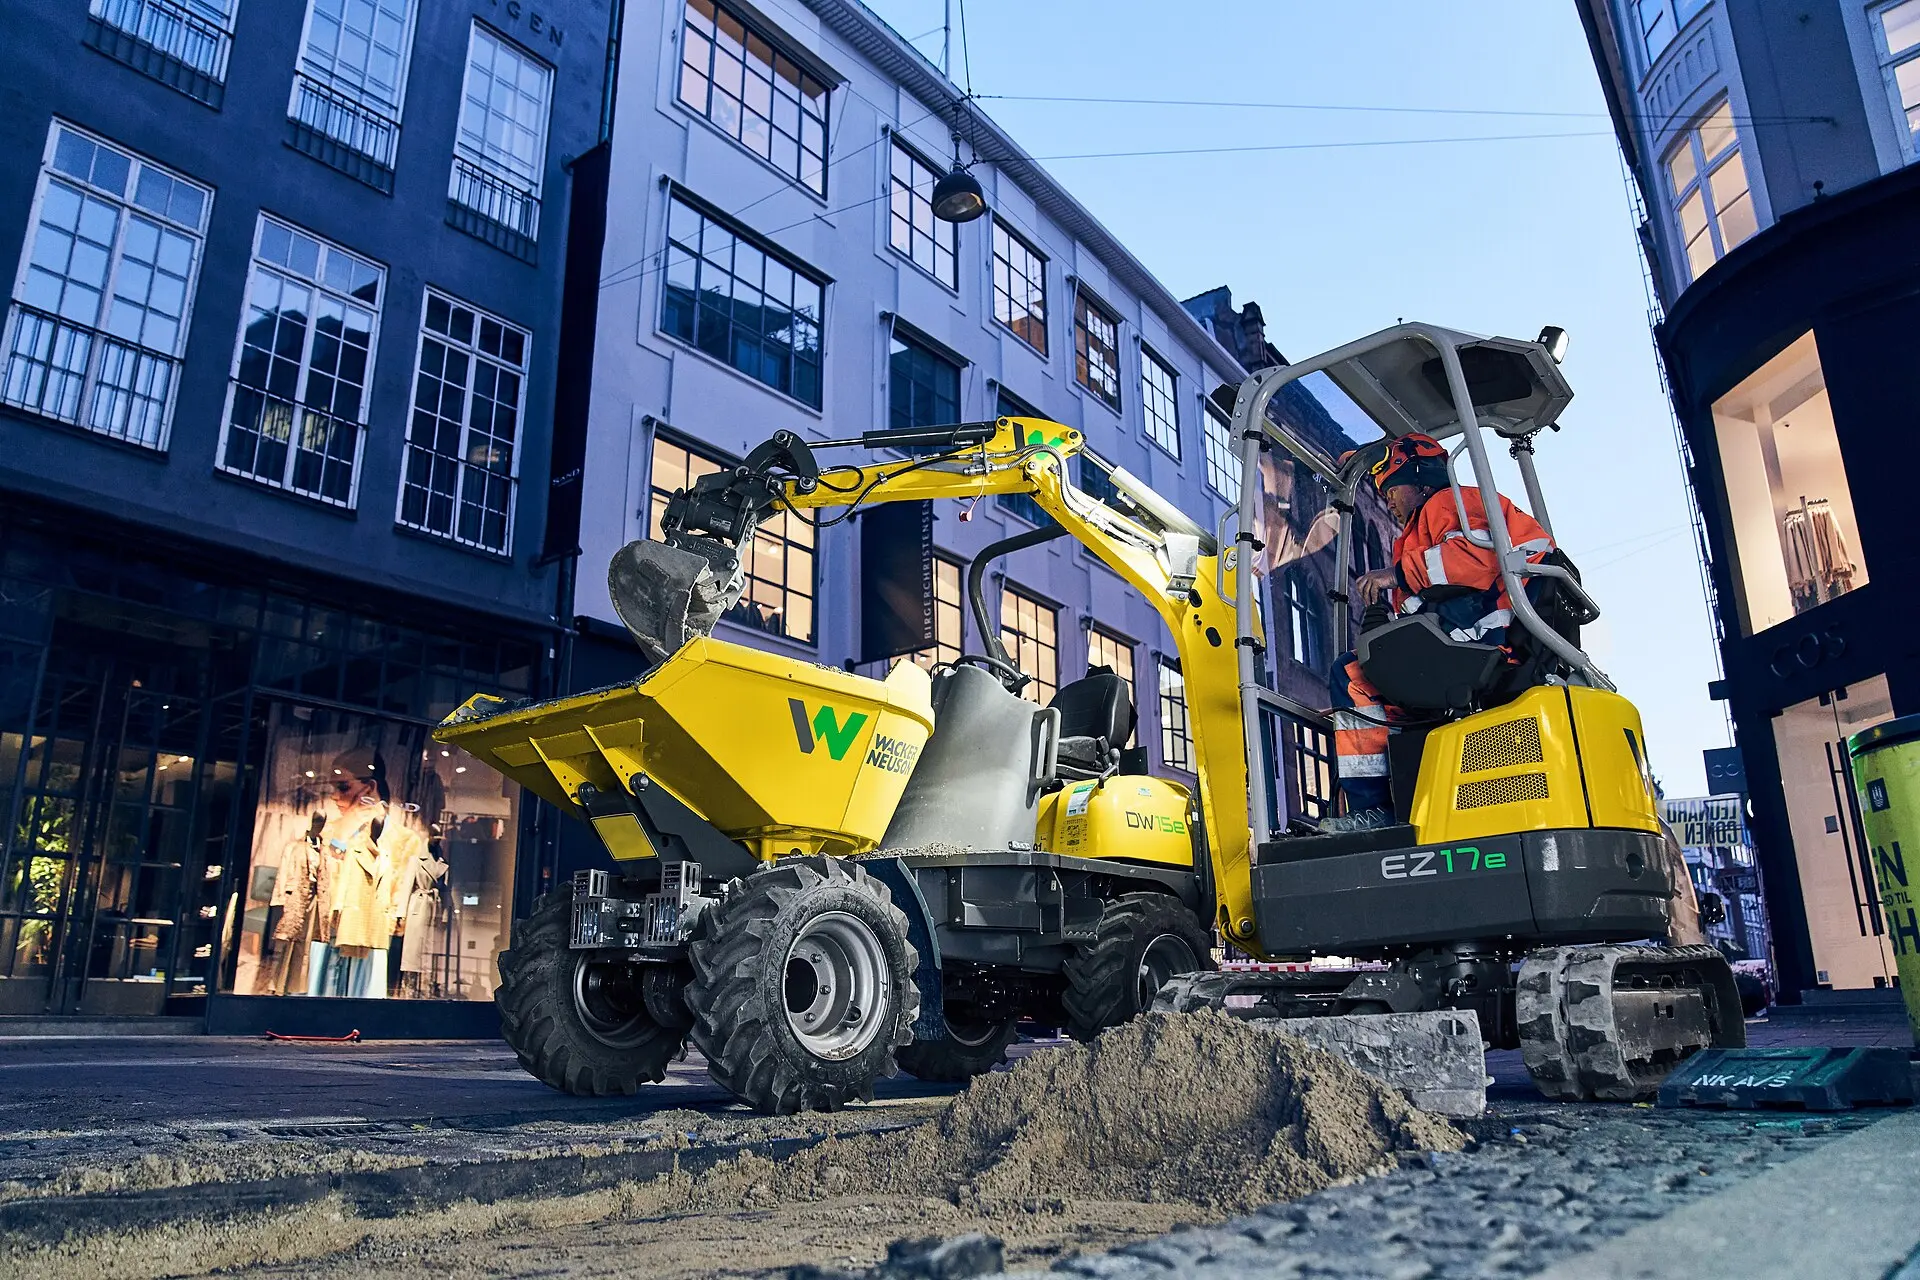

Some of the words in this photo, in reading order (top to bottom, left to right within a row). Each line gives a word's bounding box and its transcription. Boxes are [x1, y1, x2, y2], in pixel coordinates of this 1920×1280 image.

[491, 0, 563, 47] GEN
[1770, 621, 1847, 679] COS
[875, 732, 919, 761] WACKER
[865, 749, 914, 776] NEUSON
[1711, 763, 1745, 778] CO
[1125, 811, 1186, 835] DW15e
[1380, 846, 1507, 880] EZ17e
[1894, 891, 1912, 904] TIL
[1692, 1073, 1734, 1087] NK
[1733, 1070, 1795, 1088] A/S
